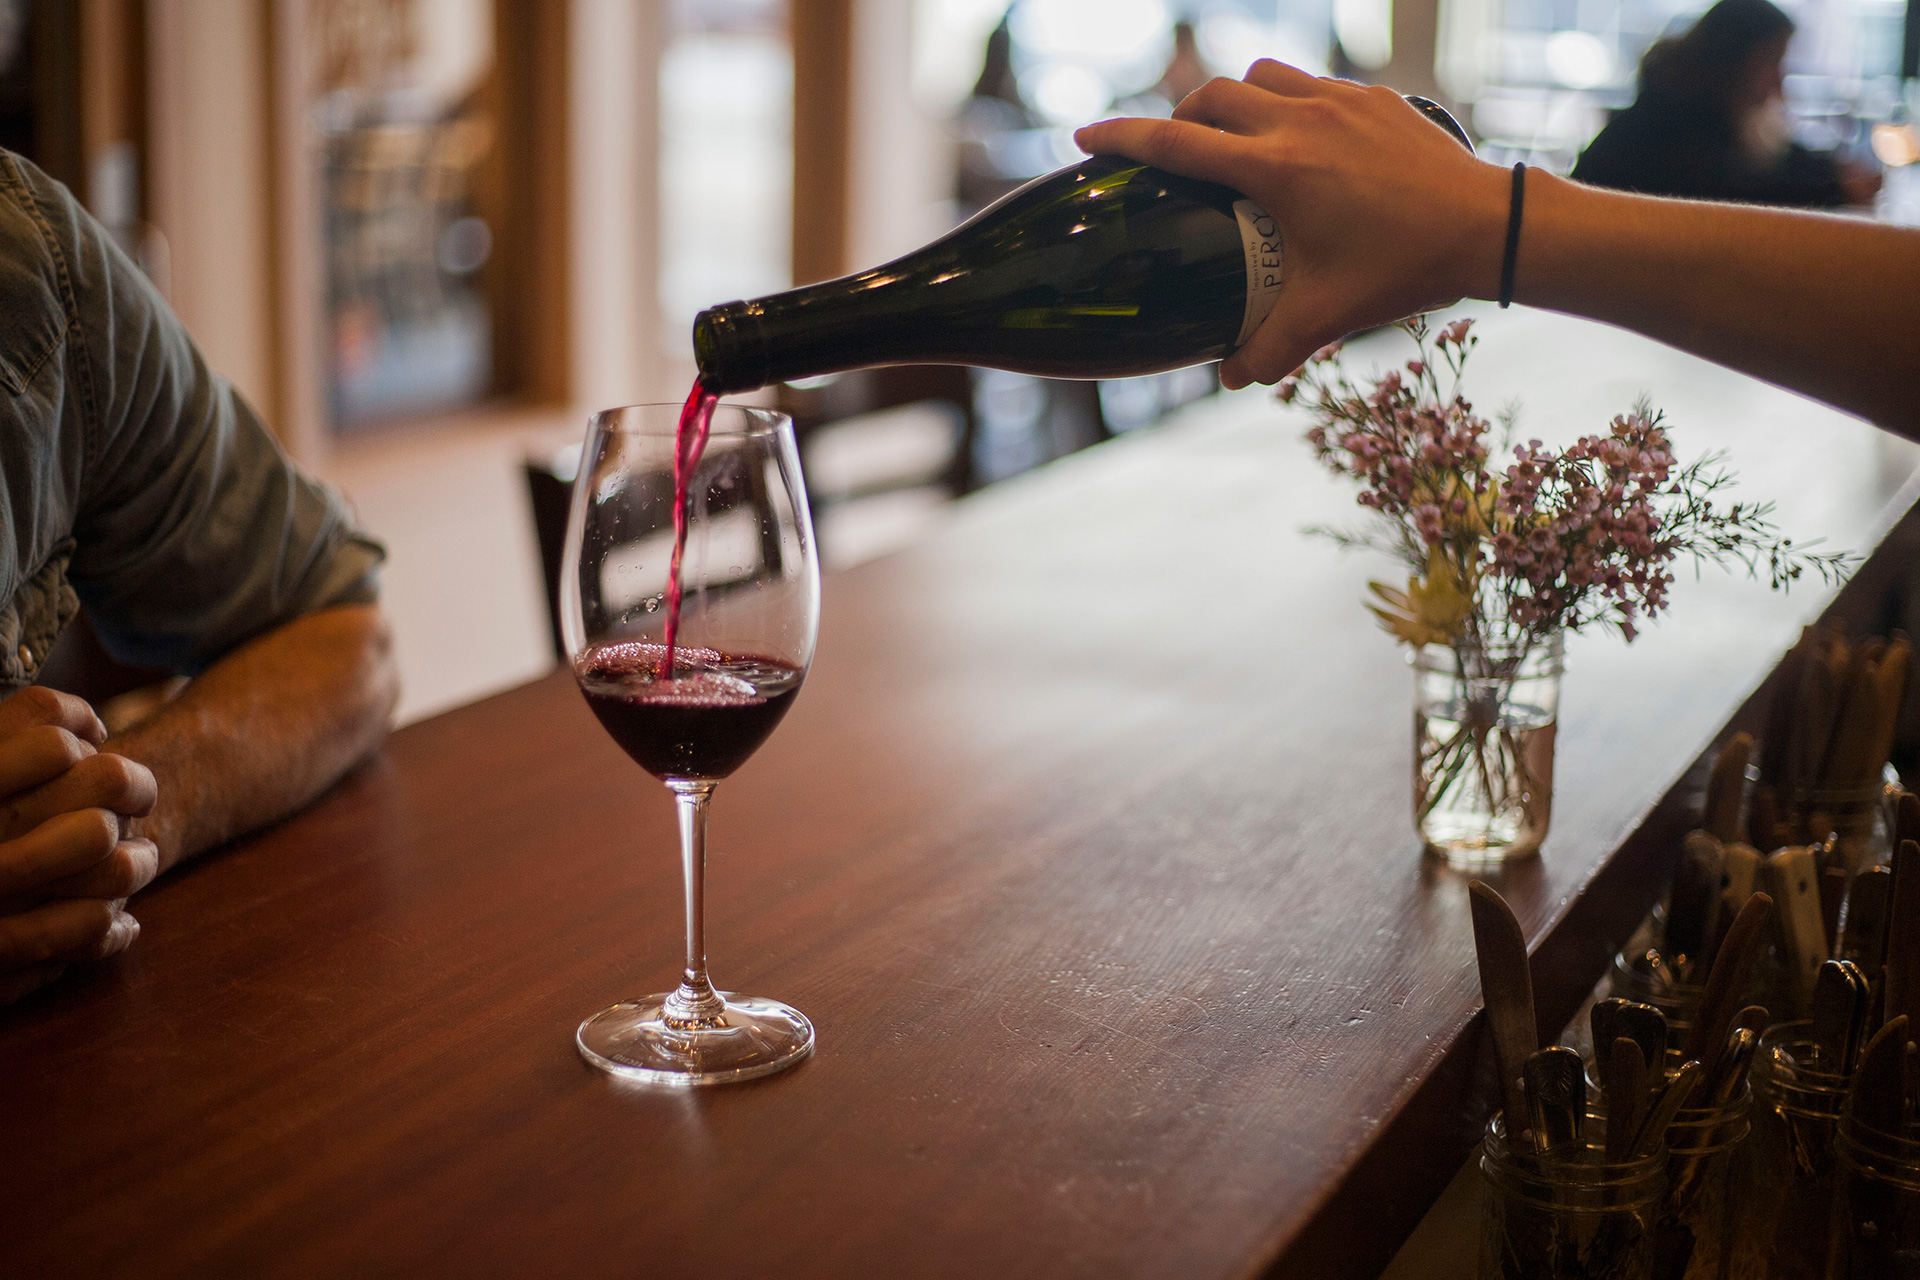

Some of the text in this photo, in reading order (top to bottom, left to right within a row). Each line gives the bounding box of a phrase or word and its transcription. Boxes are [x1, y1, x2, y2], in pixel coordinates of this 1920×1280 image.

[1249, 241, 1260, 292] Imported by
[1252, 212, 1282, 288] PERCY
